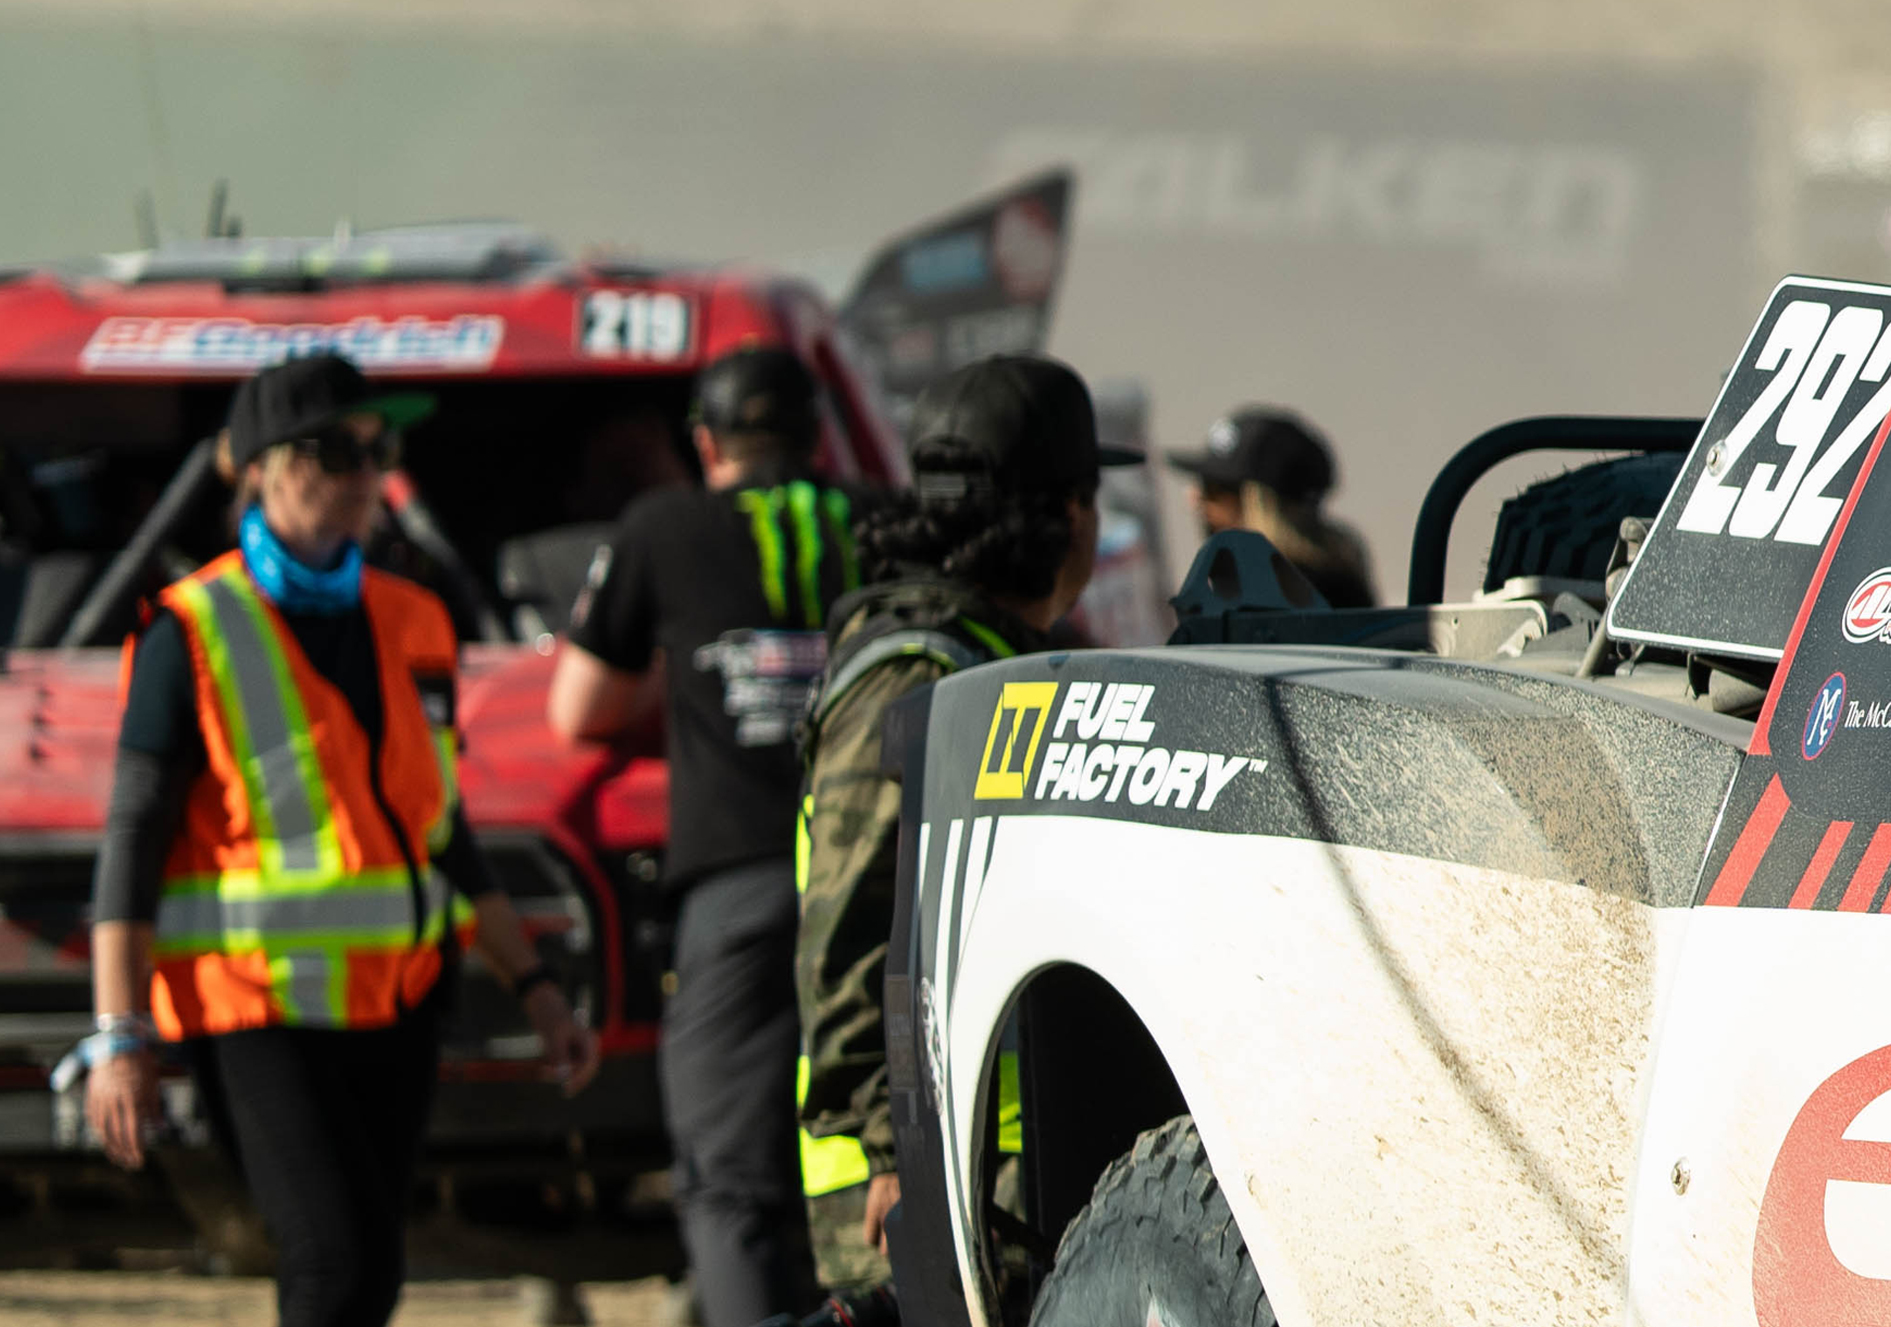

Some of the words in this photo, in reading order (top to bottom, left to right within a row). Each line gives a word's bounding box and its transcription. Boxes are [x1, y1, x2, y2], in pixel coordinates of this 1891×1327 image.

[581, 293, 689, 362] 219
[1053, 682, 1155, 742] FUEL
[1845, 700, 1866, 728] The
